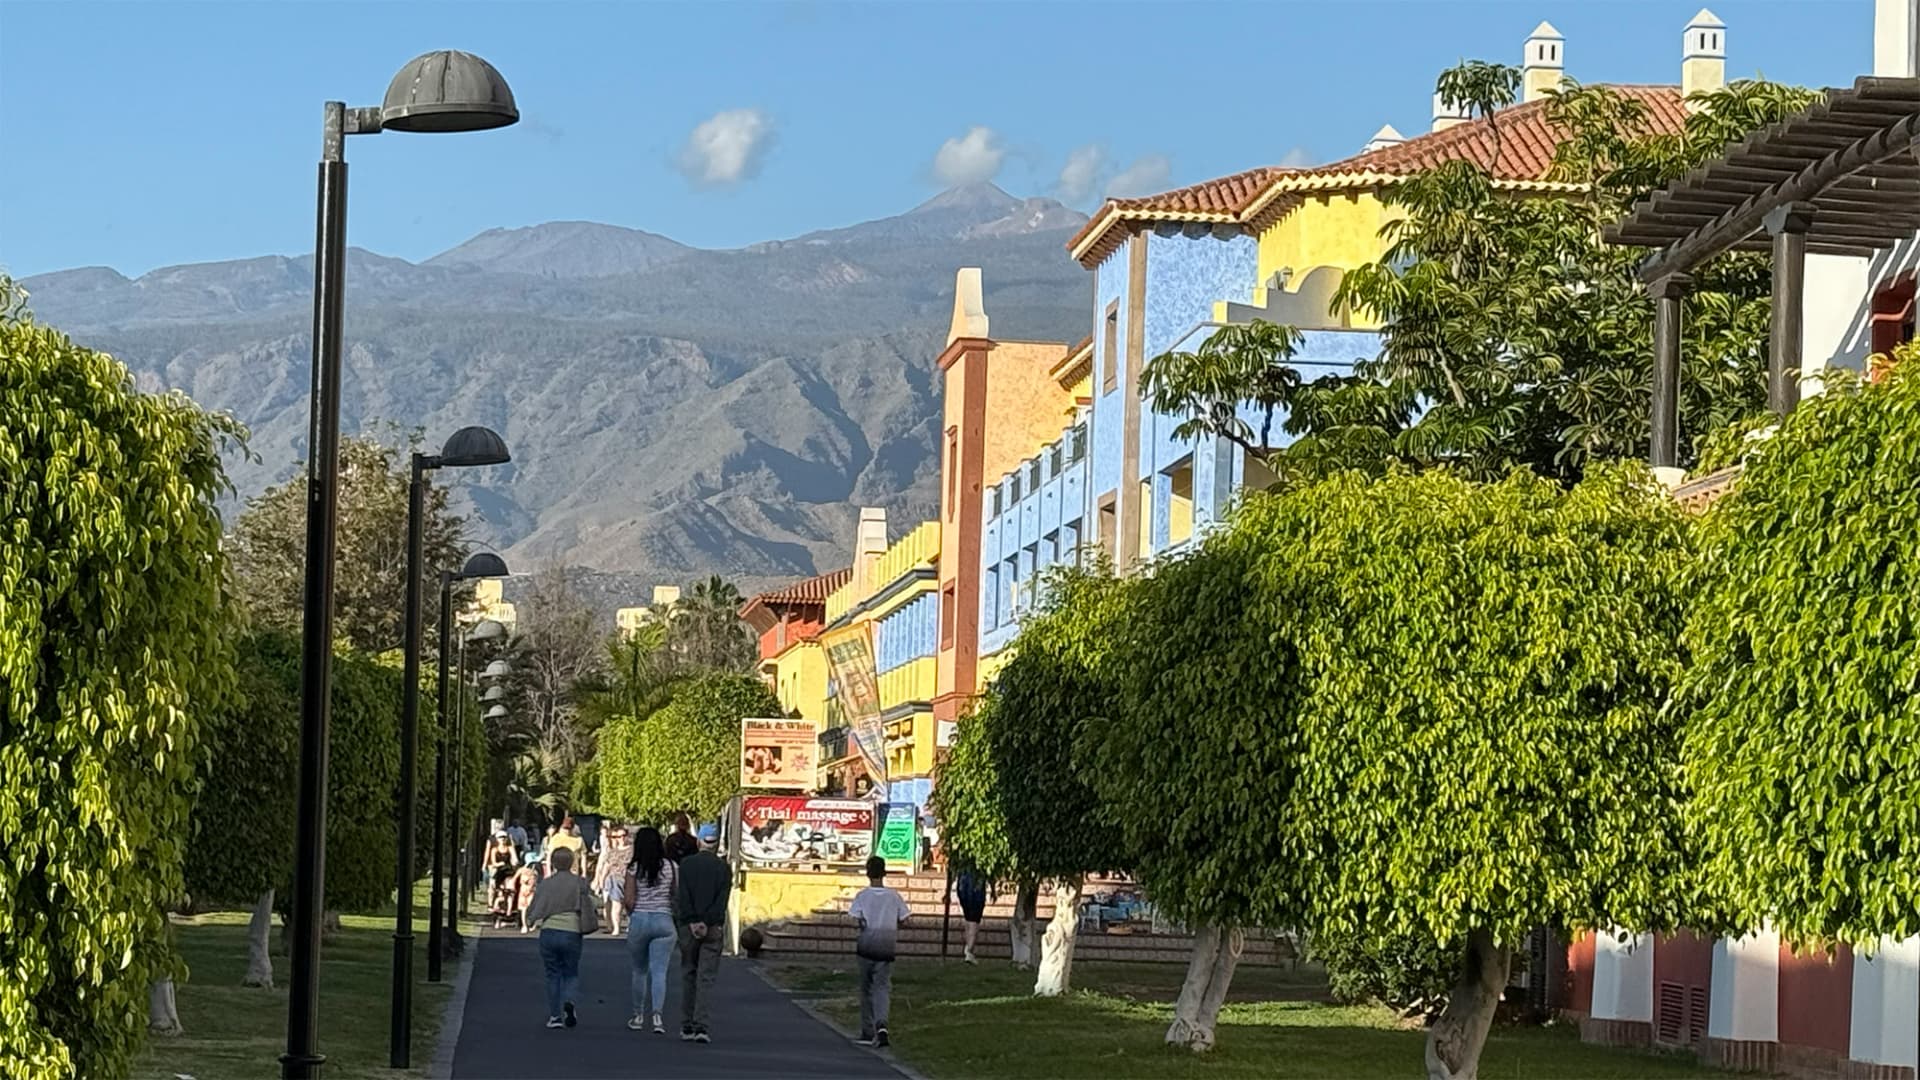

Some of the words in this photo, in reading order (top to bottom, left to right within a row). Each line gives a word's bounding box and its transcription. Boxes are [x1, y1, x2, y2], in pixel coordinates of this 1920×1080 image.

[746, 721, 771, 729] Black
[786, 722, 814, 730] White
[757, 807, 790, 820] Thai
[796, 810, 857, 825] massage
